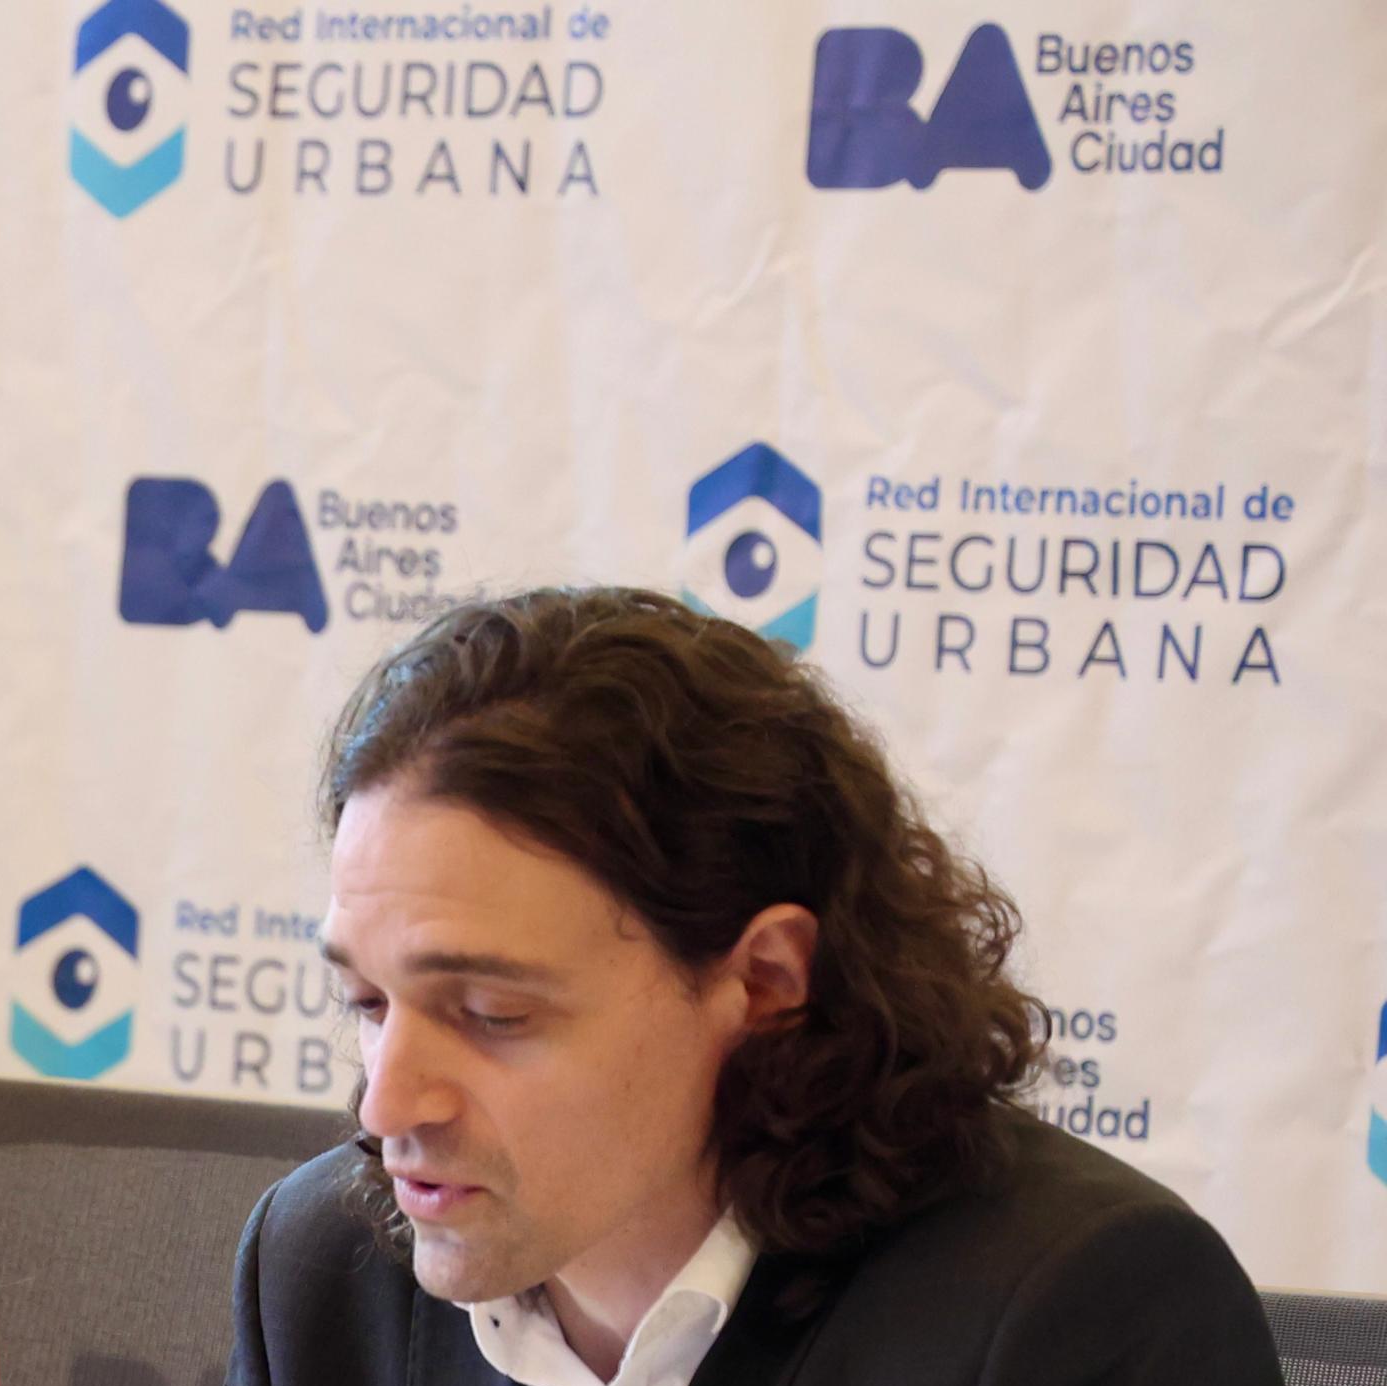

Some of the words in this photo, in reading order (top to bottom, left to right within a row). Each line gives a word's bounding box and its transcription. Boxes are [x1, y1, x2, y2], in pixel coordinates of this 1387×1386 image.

[231, 9, 301, 42] Red
[317, 6, 551, 41] Internacional
[569, 6, 609, 40] de
[1035, 34, 1195, 75] Buenos
[228, 61, 605, 120] SEGURIDAD
[1057, 83, 1176, 124] Aires
[226, 138, 600, 197] URBANA
[1070, 128, 1225, 173] Ciudad
[317, 490, 458, 532] Buenos
[866, 475, 940, 512] Red
[961, 478, 1226, 521] Internacional
[1243, 484, 1295, 522] de
[336, 538, 442, 578] Aires
[861, 530, 1287, 602] SEGURIDAD
[858, 609, 1282, 686] URBANA
[175, 899, 240, 937] Red
[1048, 1007, 1116, 1042] nos
[170, 1024, 334, 1093] URB
